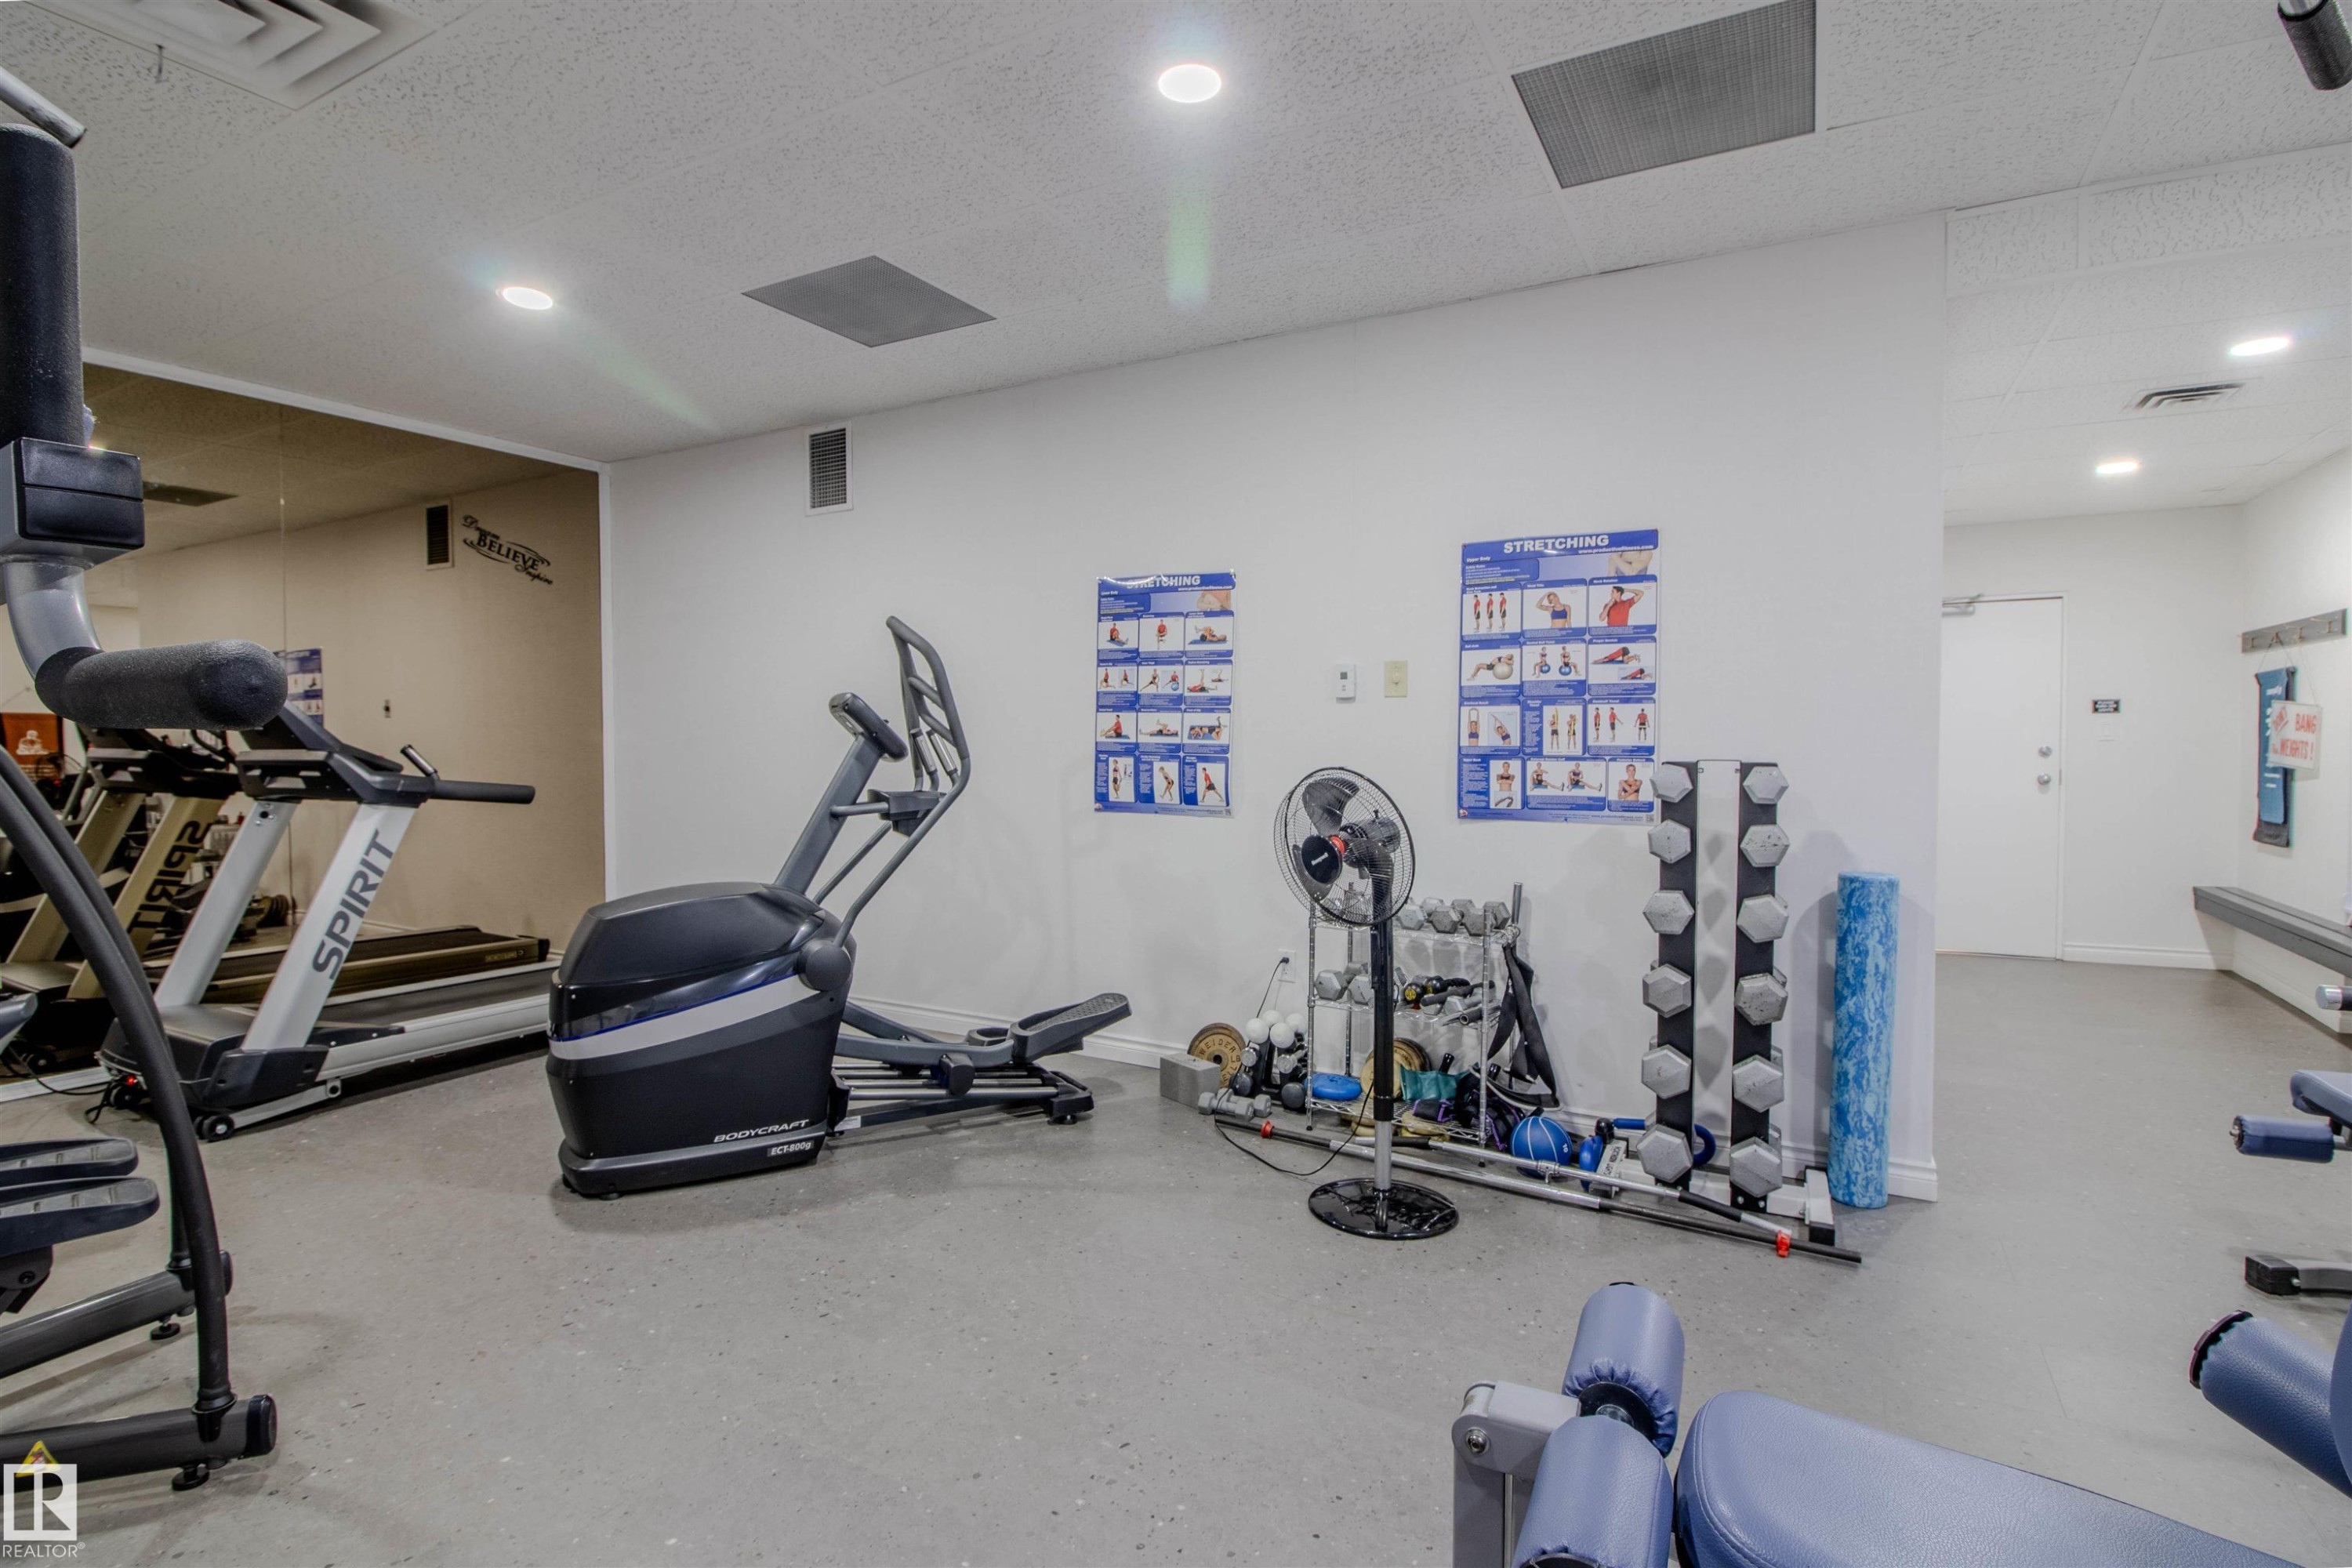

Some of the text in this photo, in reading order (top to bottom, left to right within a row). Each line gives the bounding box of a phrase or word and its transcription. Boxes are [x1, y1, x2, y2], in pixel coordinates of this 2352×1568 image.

[477, 532, 539, 570] BELIEVE
[1504, 535, 1610, 554] STRETCHING
[2295, 713, 2317, 734] BANG
[2280, 738, 2309, 760] WEIGHTS
[312, 829, 394, 979] SPIRIT
[1199, 1039, 1237, 1055] WEIDER
[714, 1120, 809, 1142] BODYCRAFT
[771, 1142, 811, 1156] ECT-800g
[1563, 1144, 1569, 1153] 10
